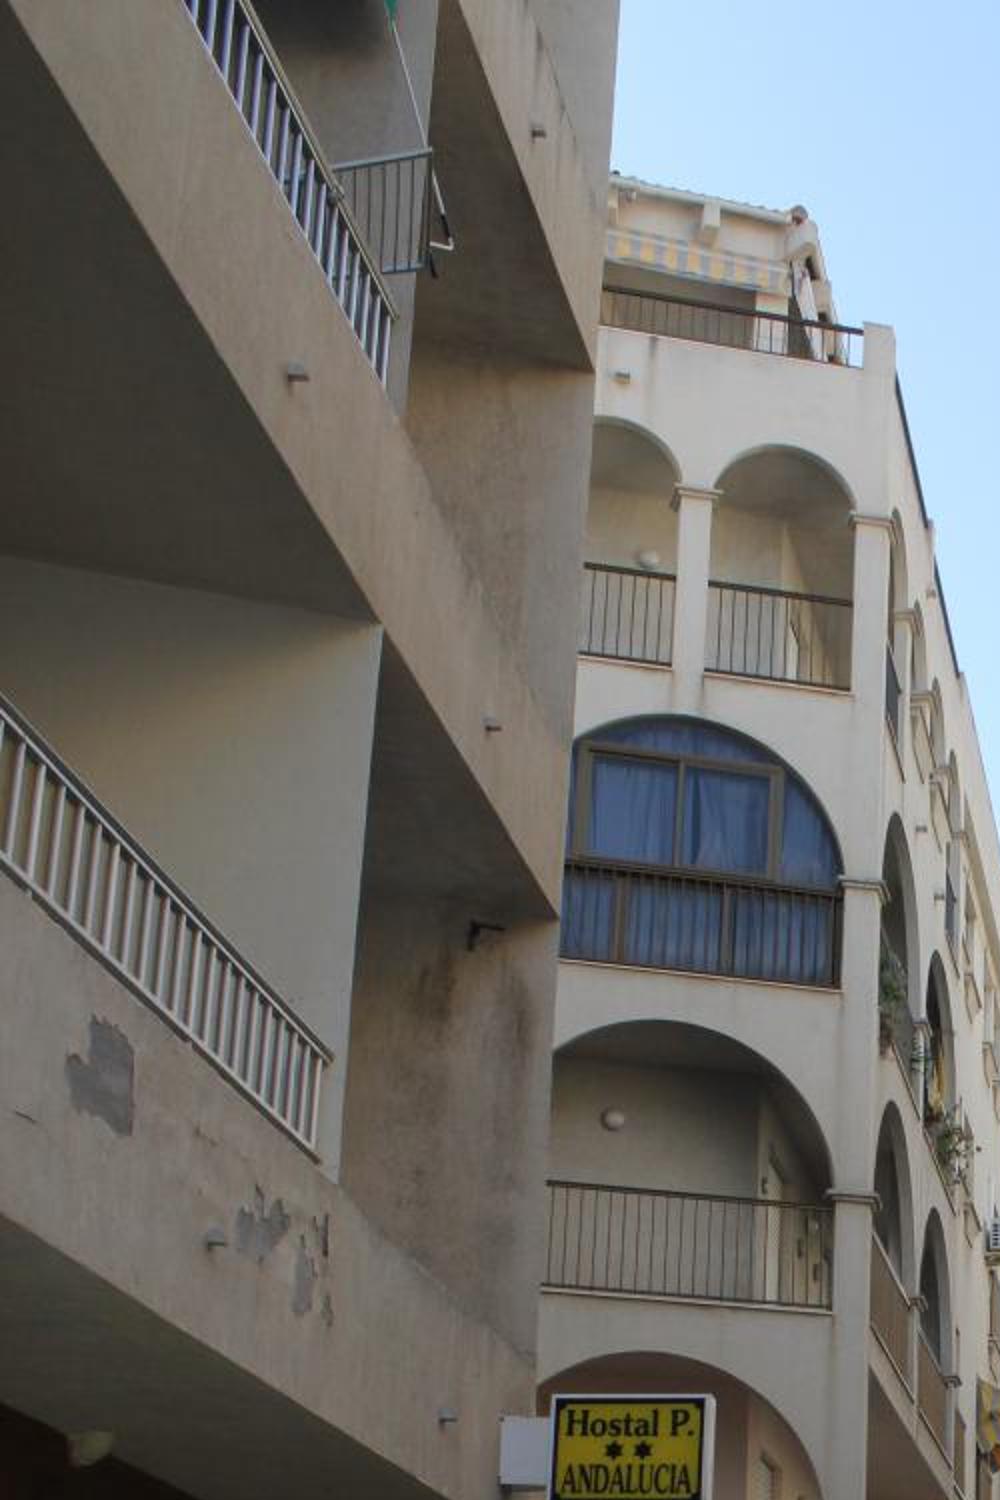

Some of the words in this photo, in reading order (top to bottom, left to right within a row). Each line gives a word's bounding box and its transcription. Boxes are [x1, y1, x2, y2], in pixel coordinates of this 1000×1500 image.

[566, 1408, 659, 1437] Hostal
[670, 1408, 695, 1437] P.
[561, 1463, 692, 1495] ANDALUCIA
